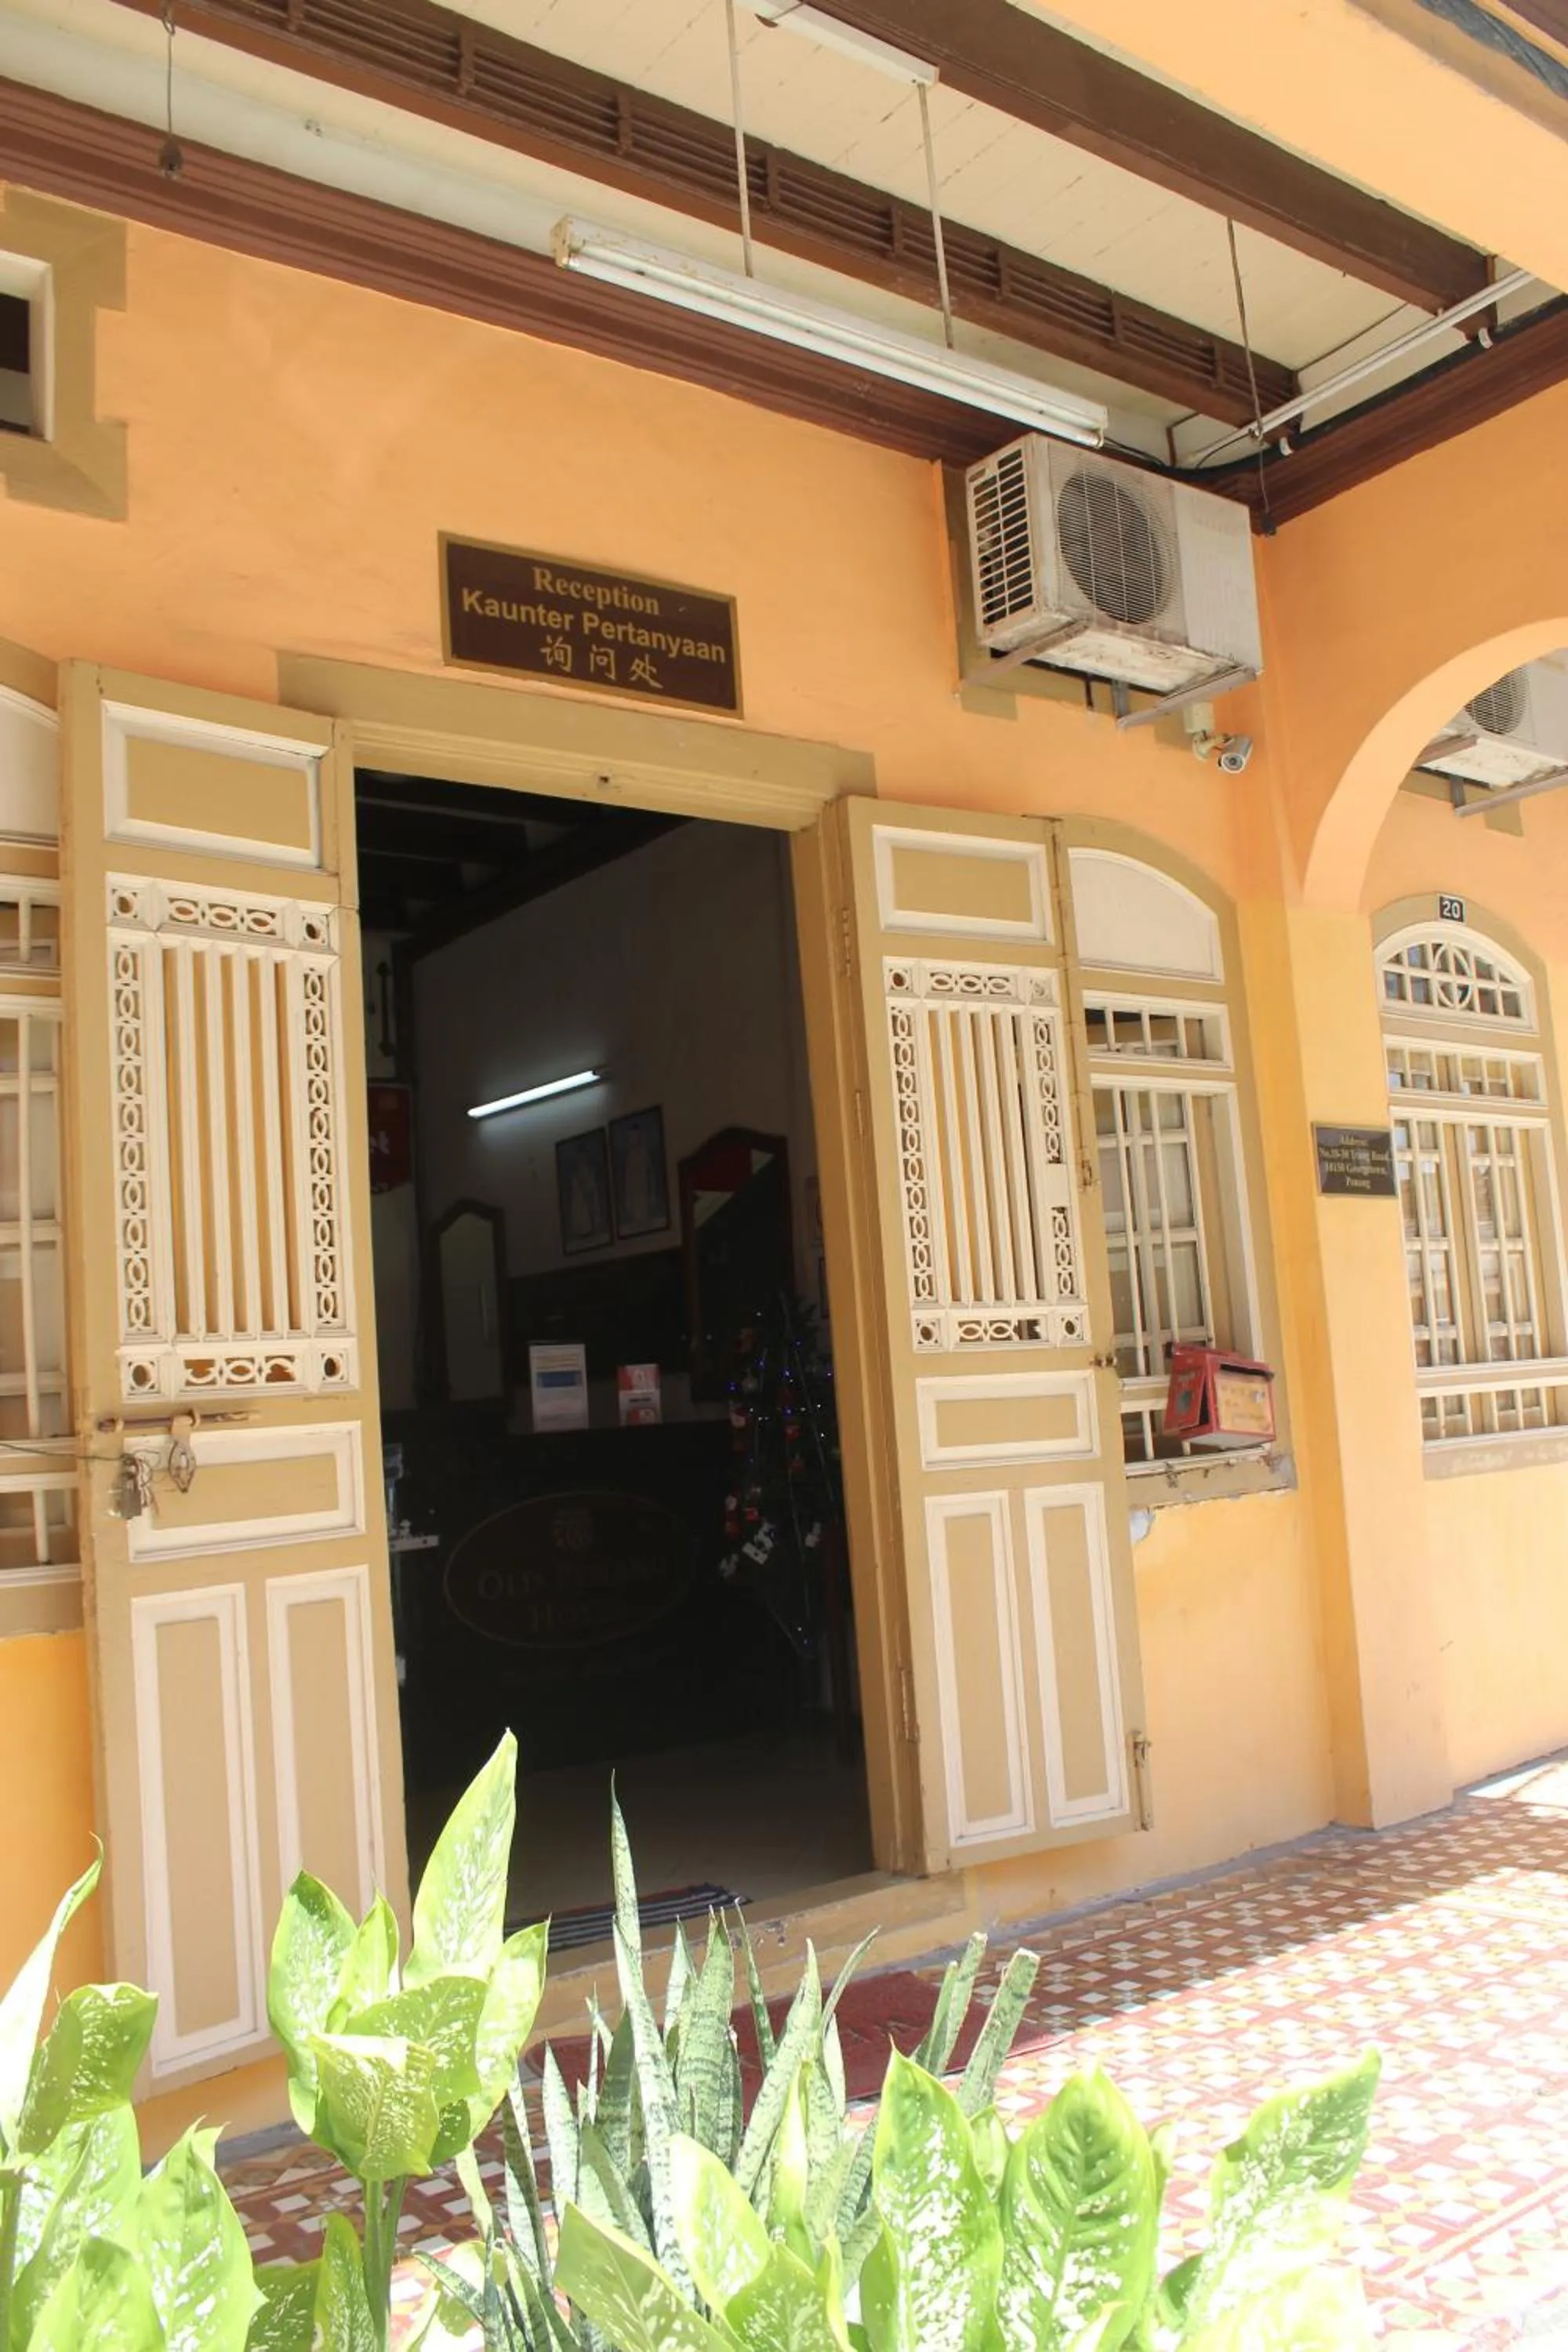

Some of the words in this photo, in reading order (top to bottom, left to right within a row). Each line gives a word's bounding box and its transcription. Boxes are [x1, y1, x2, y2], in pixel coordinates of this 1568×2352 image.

[532, 566, 660, 616] Reception
[462, 587, 574, 632] Kaunter
[583, 612, 726, 664] Pertanyaan
[540, 635, 663, 688] 询问处
[1443, 900, 1461, 919] 20
